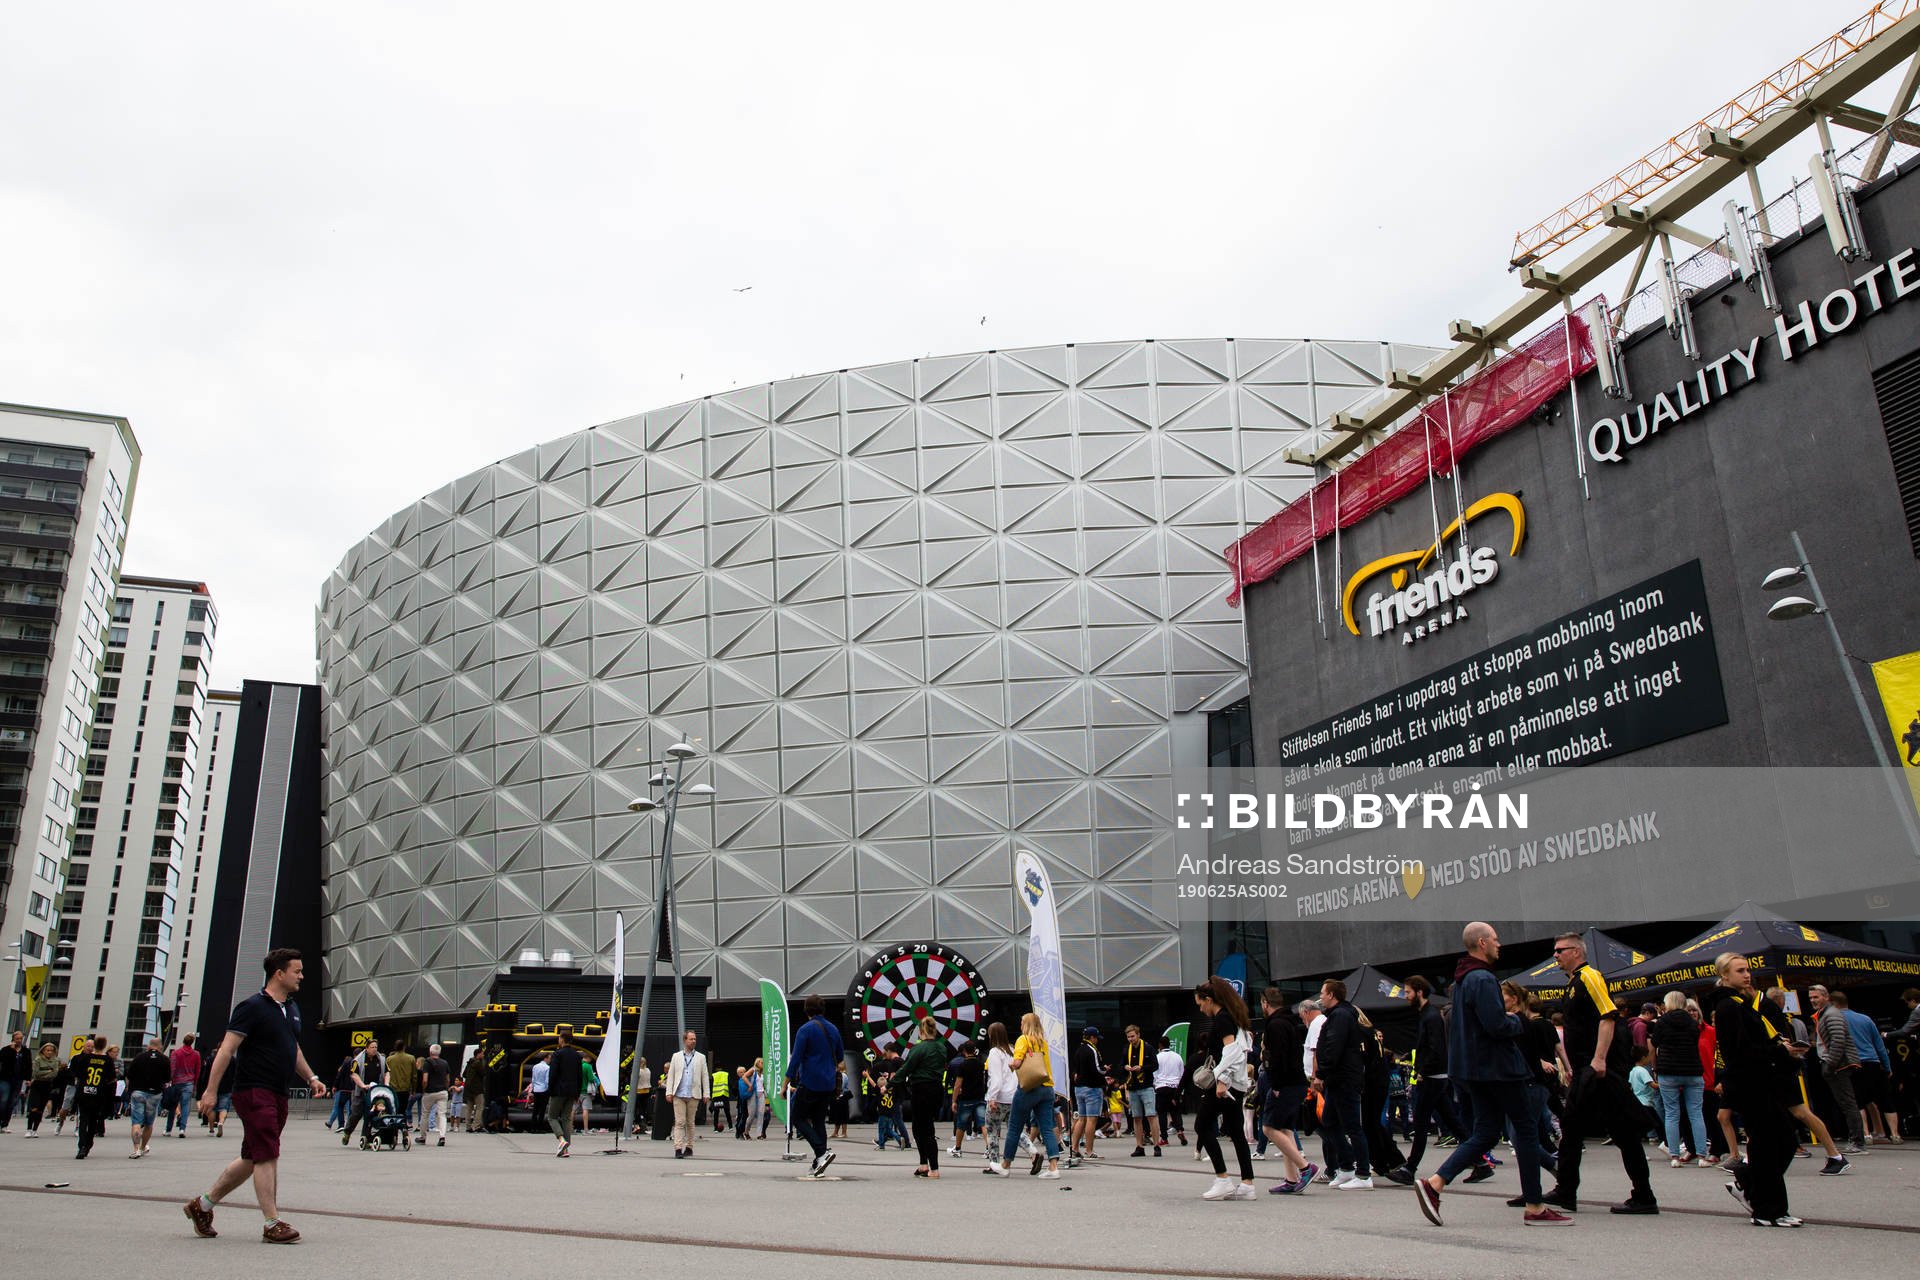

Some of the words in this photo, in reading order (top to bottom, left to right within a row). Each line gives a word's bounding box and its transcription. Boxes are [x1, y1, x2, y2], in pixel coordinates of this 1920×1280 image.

[1588, 336, 1760, 463] QUALITY
[1366, 544, 1499, 637] friends
[1402, 605, 1469, 646] ARENA
[1282, 729, 1330, 759] Stiftelsen
[1332, 709, 1372, 739] Friends
[1375, 702, 1394, 721] har
[1397, 694, 1402, 712] i
[1405, 675, 1457, 711] uppdrag
[1460, 661, 1480, 685] att
[1484, 645, 1533, 676] stoppa
[1537, 609, 1615, 655] mobbning
[1619, 589, 1664, 620] inom
[1285, 763, 1311, 788] såväl
[1314, 753, 1342, 777] skola
[1345, 745, 1368, 765] som
[1370, 726, 1406, 756] idrott.
[1409, 717, 1428, 741] Ett
[1431, 699, 1473, 733] viktigt
[1477, 683, 1522, 715] arbete
[1527, 671, 1559, 696] som
[1564, 658, 1578, 682] vi
[1584, 648, 1605, 681] på
[1609, 611, 1704, 664] Swedbank
[1371, 767, 1385, 792] på
[1388, 757, 1425, 782] denna
[1428, 743, 1465, 768] arena
[1469, 733, 1484, 755] är
[1488, 728, 1505, 748] en
[1510, 696, 1598, 746] påminnelse
[1604, 680, 1630, 708] att
[1634, 660, 1682, 697] inget
[1290, 827, 1312, 846] barn
[1452, 762, 1503, 795] ensamt
[1507, 754, 1541, 778] eller
[1547, 727, 1613, 767] mobbat.
[1296, 886, 1349, 918] FRIENDS
[1352, 874, 1400, 907] ARENA
[1430, 859, 1464, 889] MED
[1469, 844, 1512, 881] STÖD
[1518, 840, 1539, 870] AV
[1544, 811, 1661, 863] SWEDBANK
[897, 946, 905, 955] 5
[914, 944, 927, 952] 20
[937, 947, 943, 955] 1
[877, 954, 890, 967] 12
[951, 955, 964, 967] 18
[1786, 954, 1800, 966] AIK
[1803, 956, 1826, 968] SHOP
[1835, 957, 1872, 970] OFFICIAL
[1873, 959, 1920, 975] MERCHAND
[865, 970, 873, 978] 9
[968, 971, 976, 979] 4
[1609, 981, 1622, 993] AIK
[1624, 977, 1647, 991] SHOP
[1655, 968, 1694, 985] OFFICIAL
[855, 985, 865, 998] 14
[976, 985, 986, 998] 13
[852, 1008, 860, 1020] 11
[977, 1028, 987, 1041] 10
[86, 1066, 103, 1086] 36
